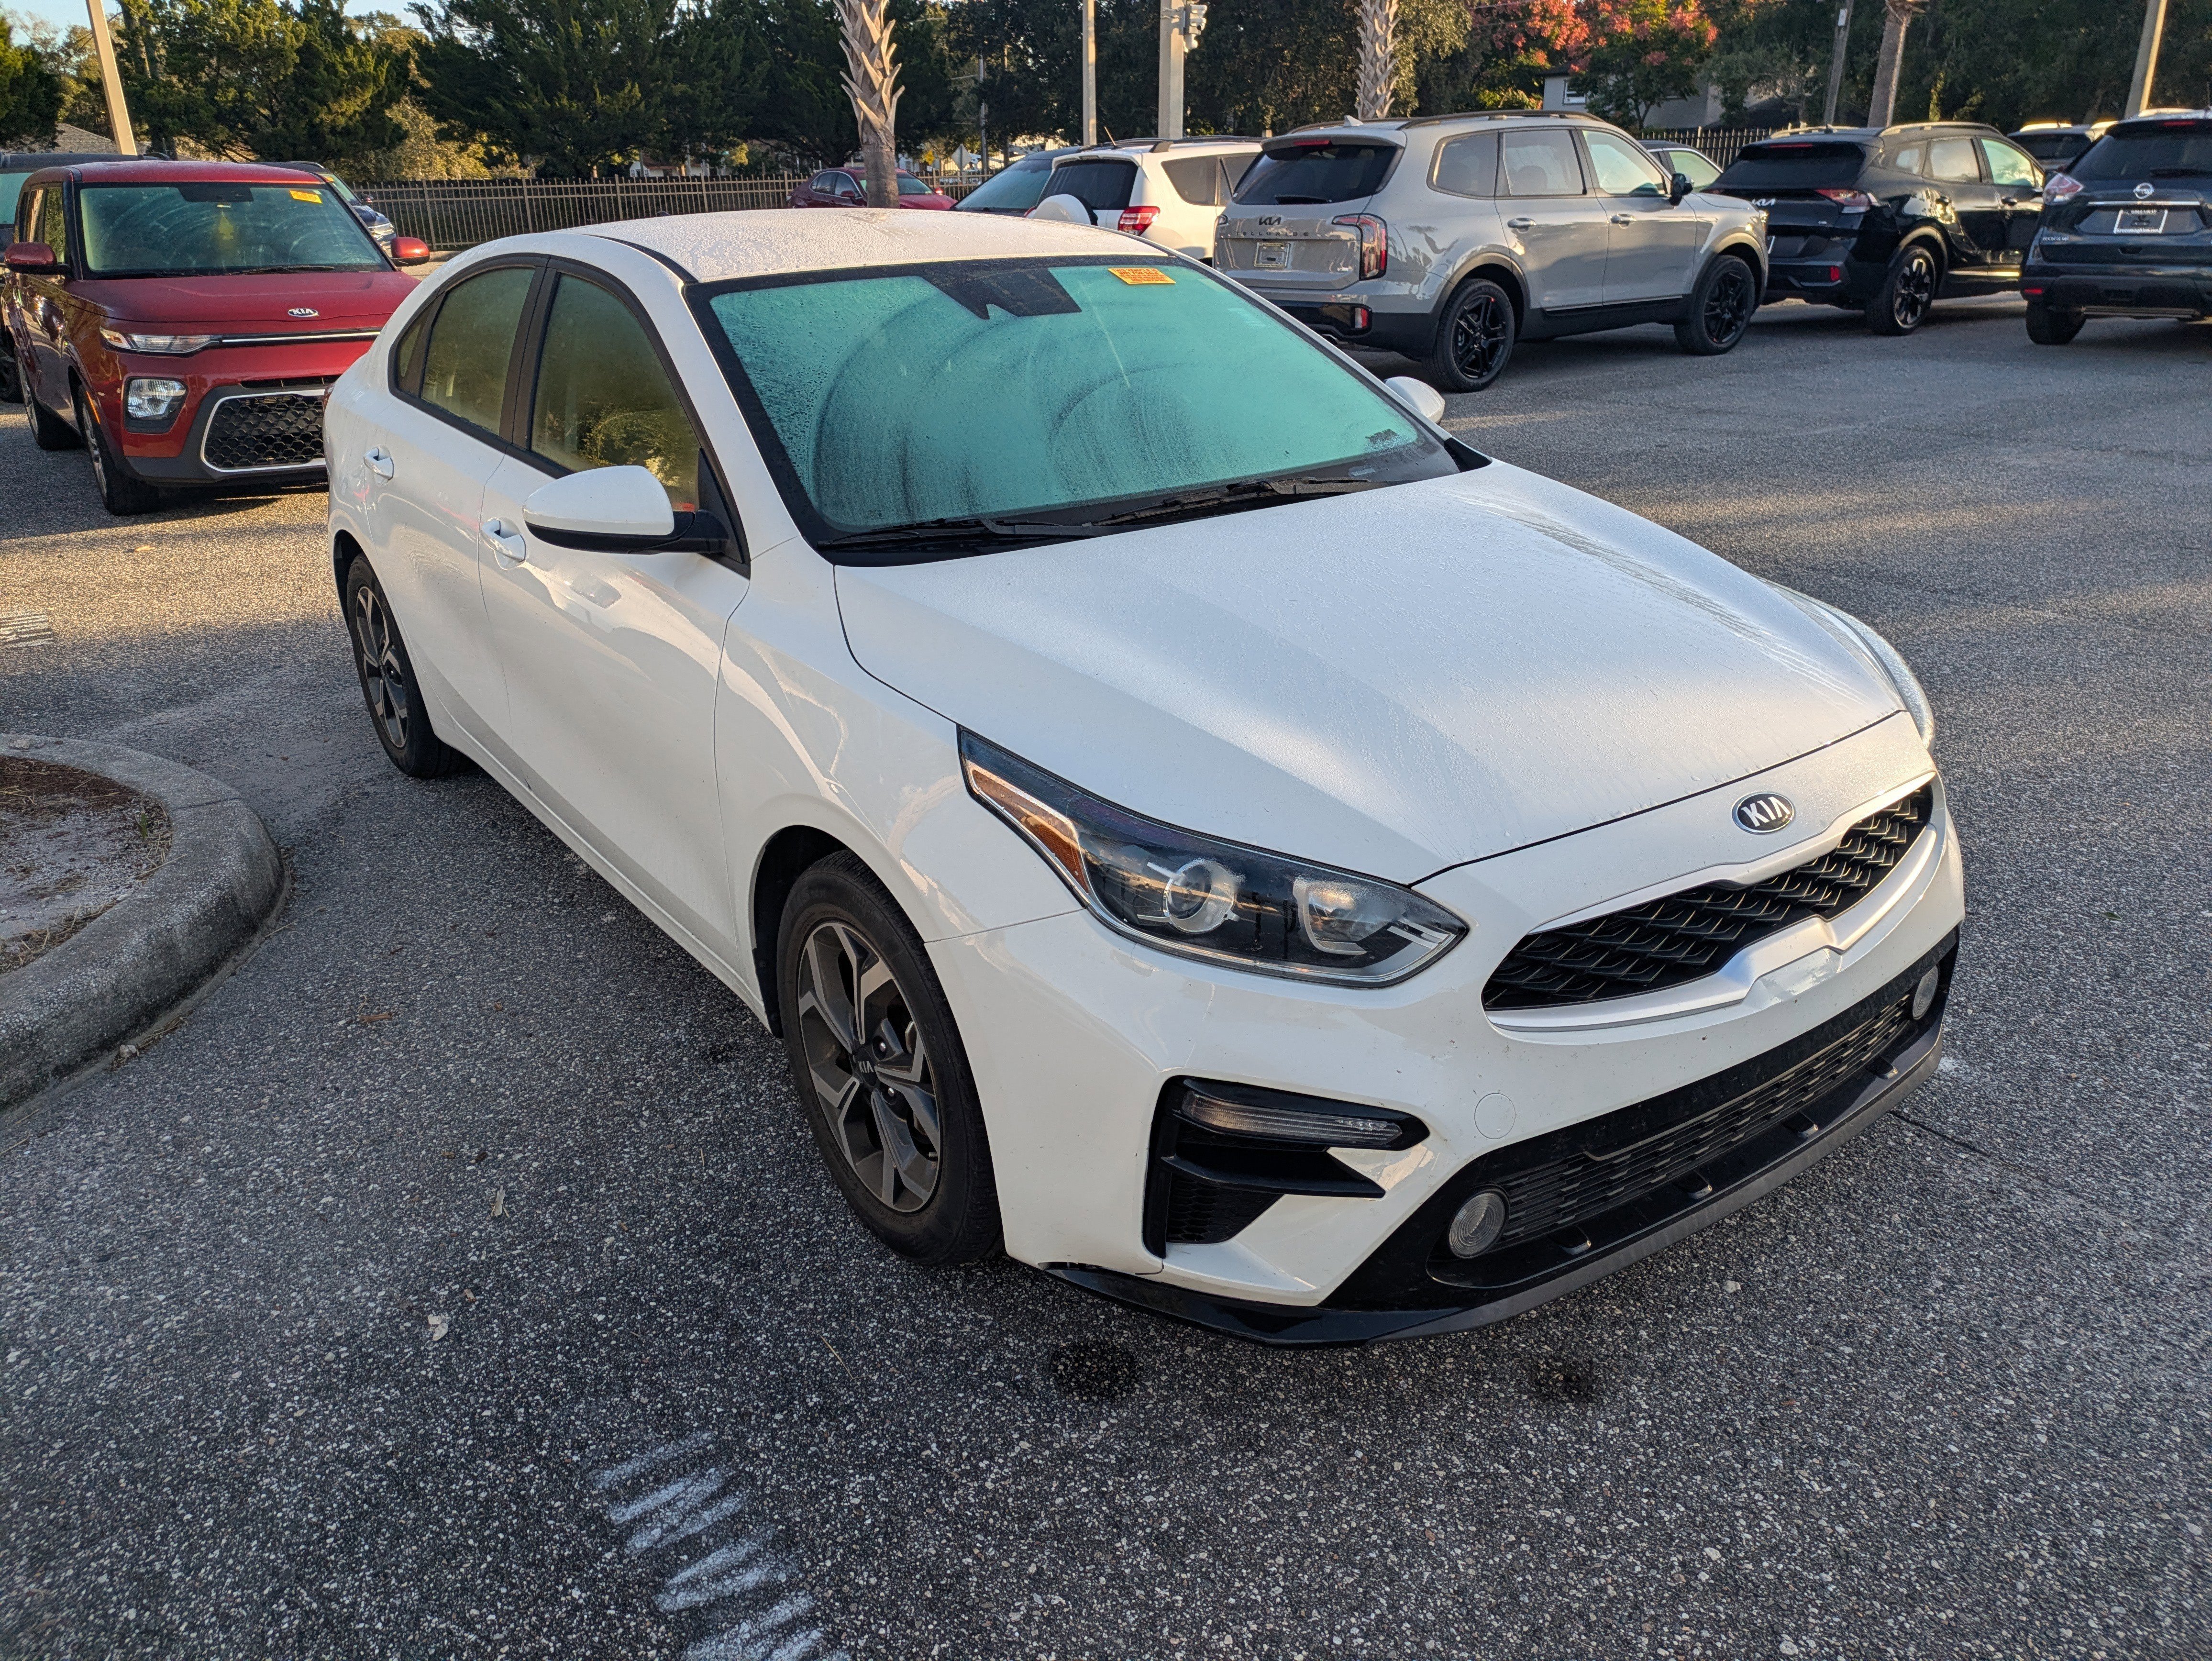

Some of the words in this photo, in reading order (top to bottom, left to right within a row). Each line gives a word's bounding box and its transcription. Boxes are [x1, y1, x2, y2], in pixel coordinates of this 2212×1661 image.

[1259, 217, 1282, 225] KIA
[1740, 796, 1791, 827] KIA
[858, 1061, 874, 1073] KIA
